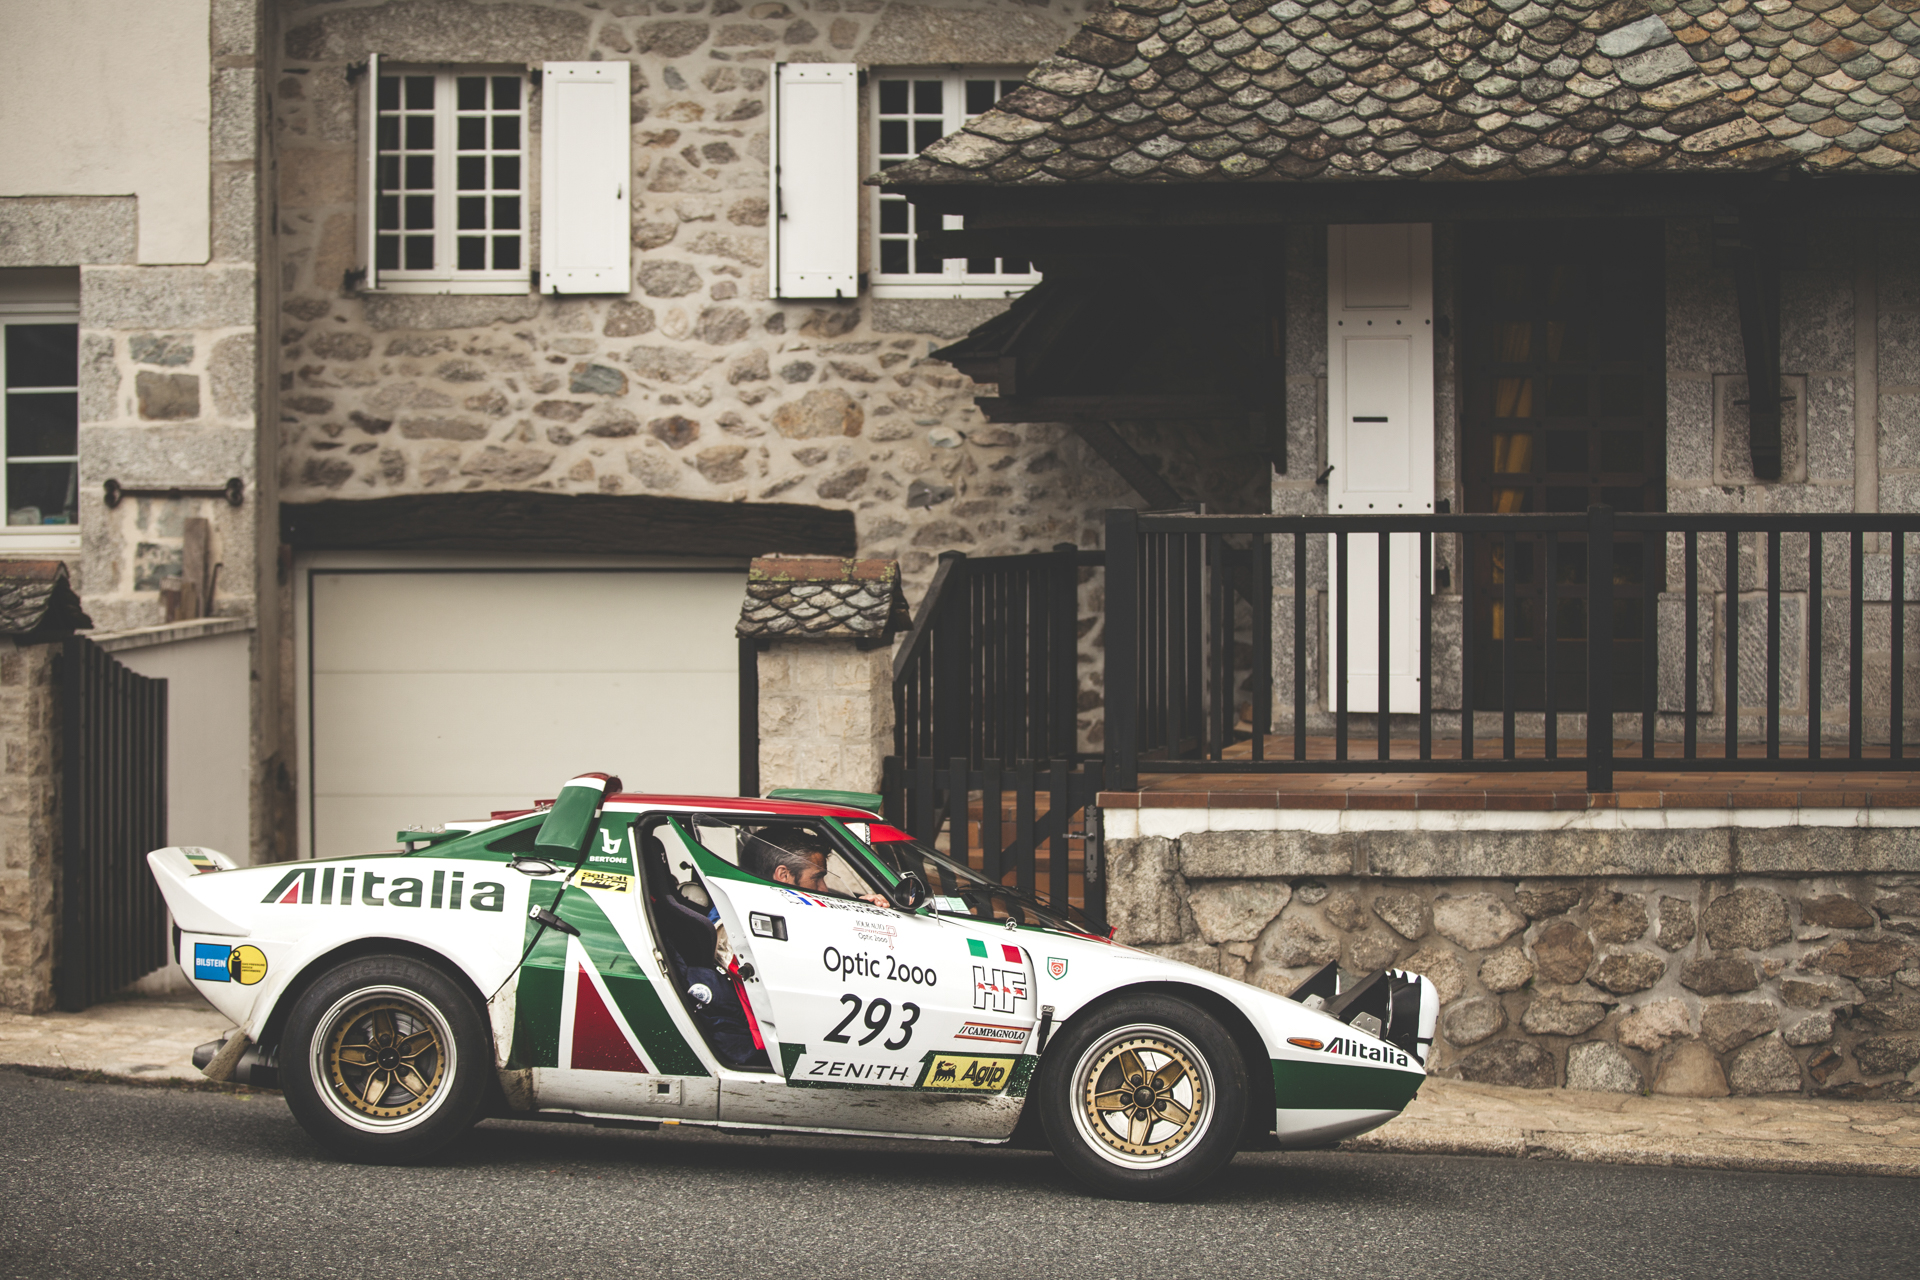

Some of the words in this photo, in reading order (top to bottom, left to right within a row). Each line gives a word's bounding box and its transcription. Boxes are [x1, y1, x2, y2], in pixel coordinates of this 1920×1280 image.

[589, 856, 628, 864] BERTONE
[583, 872, 628, 881] Sabelt
[260, 867, 505, 912] Alitalia
[858, 932, 873, 941] Optic
[874, 934, 888, 944] 2000
[196, 957, 227, 968] BILSTEIN
[823, 946, 880, 982] Optic
[886, 955, 937, 987] 2000
[972, 965, 1028, 1014] HF
[823, 993, 921, 1051] 293
[967, 1026, 1026, 1040] CAMPAGNOLO
[1323, 1037, 1408, 1067] Alitalia
[809, 1060, 909, 1081] ZENITH
[961, 1060, 1005, 1087] Agip
